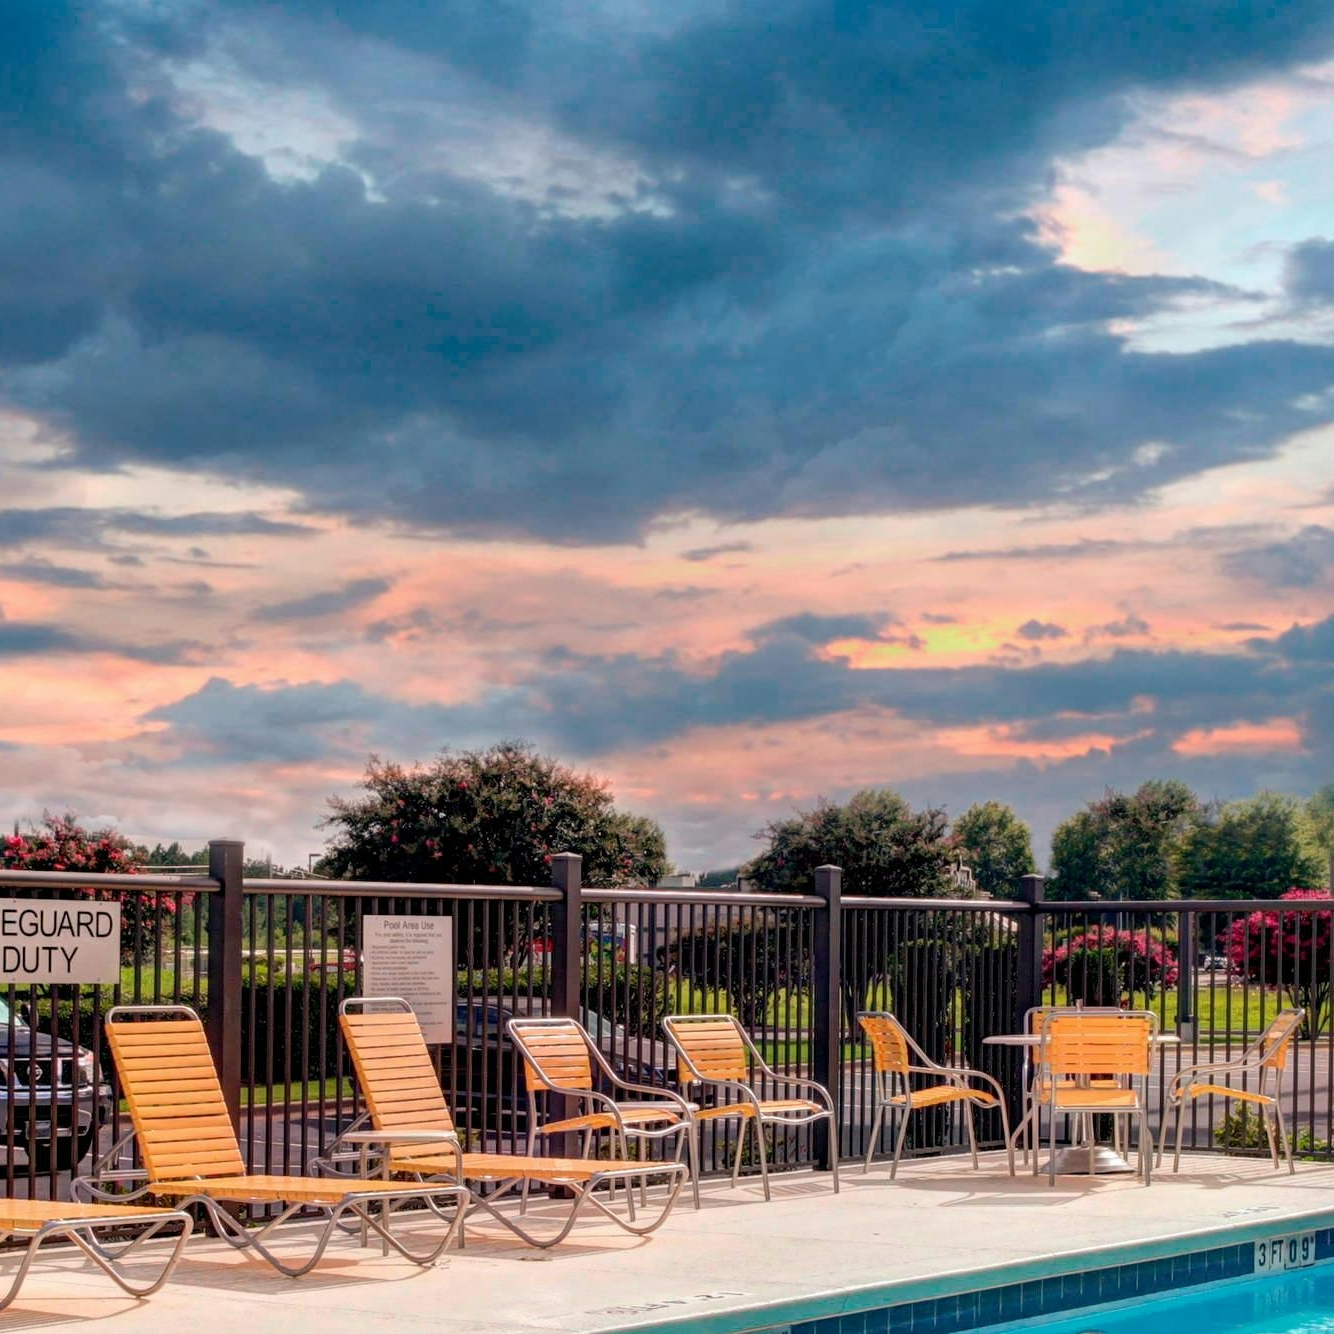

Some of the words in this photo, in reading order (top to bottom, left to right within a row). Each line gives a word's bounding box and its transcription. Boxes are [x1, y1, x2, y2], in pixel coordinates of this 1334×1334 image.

[383, 920, 401, 930] Pool
[402, 920, 420, 930] Area
[421, 920, 435, 930] Use
[2, 946, 79, 973] DUTY
[1258, 1243, 1267, 1267] 3
[1271, 1239, 1284, 1265] FT
